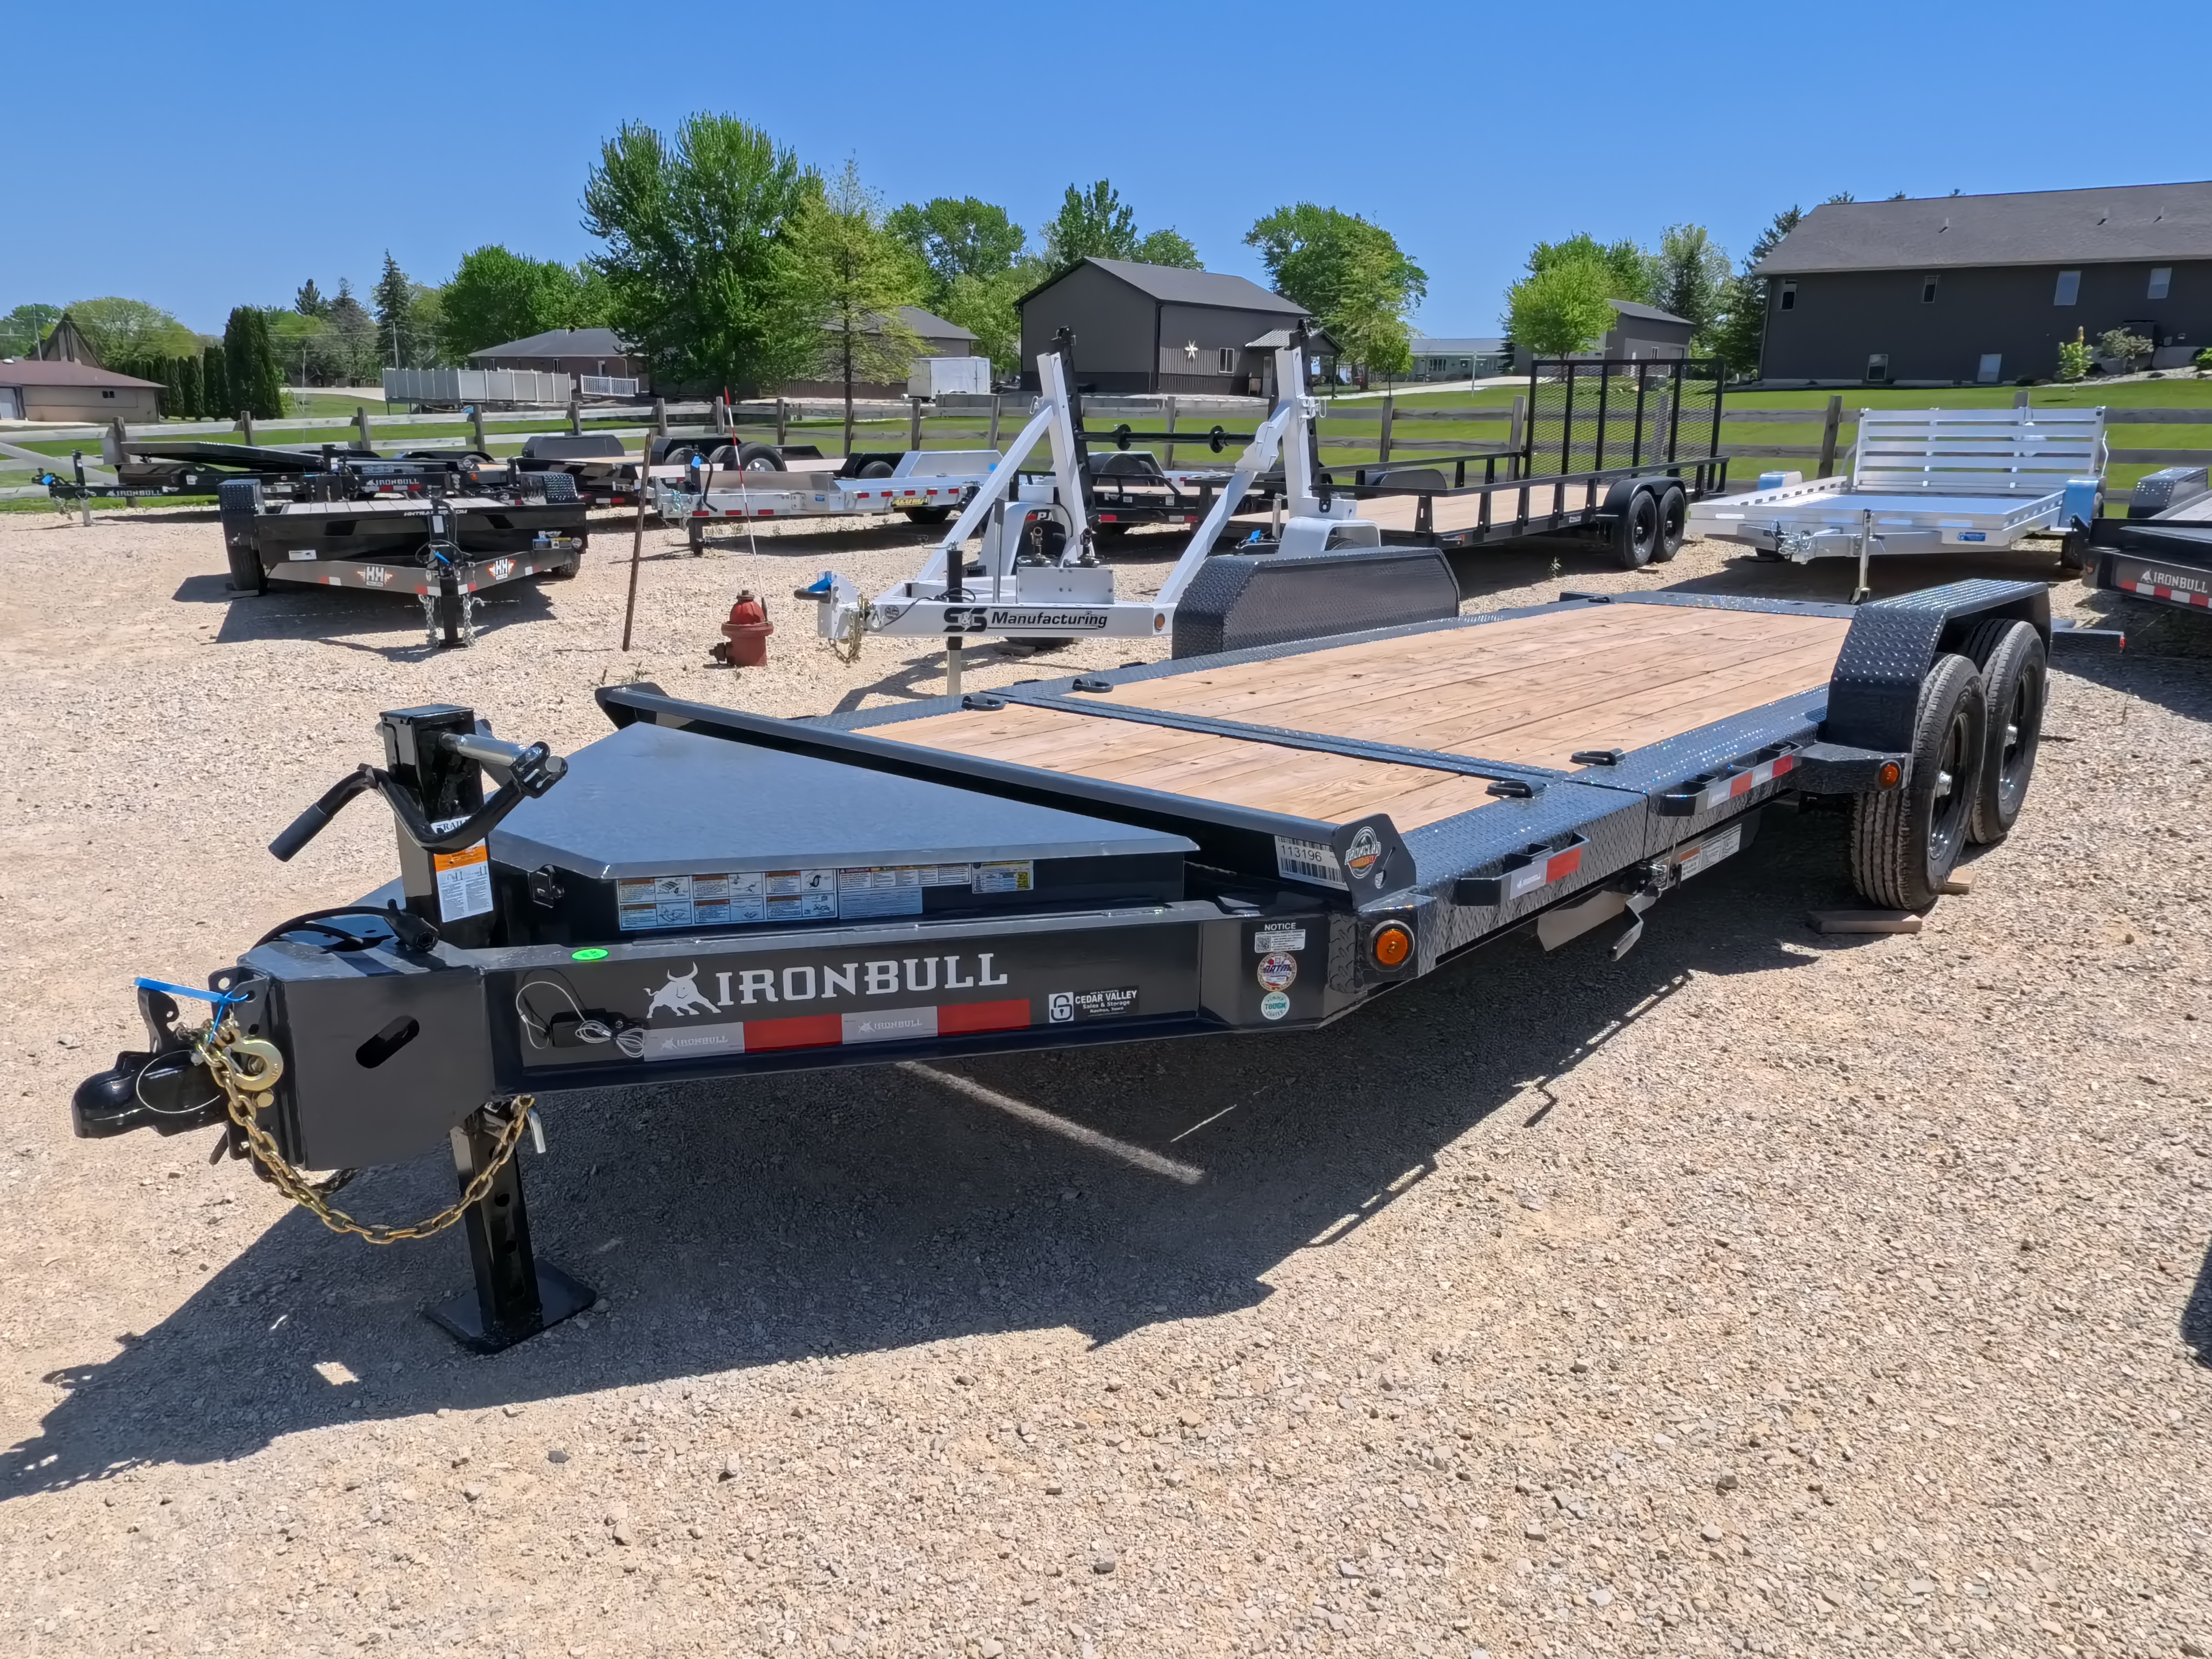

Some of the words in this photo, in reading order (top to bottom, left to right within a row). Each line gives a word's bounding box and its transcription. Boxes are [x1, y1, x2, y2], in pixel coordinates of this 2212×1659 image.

[367, 567, 384, 582] HH
[495, 558, 508, 575] HH
[2154, 571, 2208, 593] IRONBULL
[991, 611, 1108, 628] Manufacturing
[1280, 845, 1322, 862] 113196
[1264, 922, 1296, 931] NOTICE
[716, 953, 1008, 1006] IRONBULL
[1075, 994, 1103, 1004] CEDAR
[1105, 990, 1137, 1001] VALLEY
[874, 1019, 922, 1030] IRONBULL
[677, 1034, 728, 1047] IRONBULL
